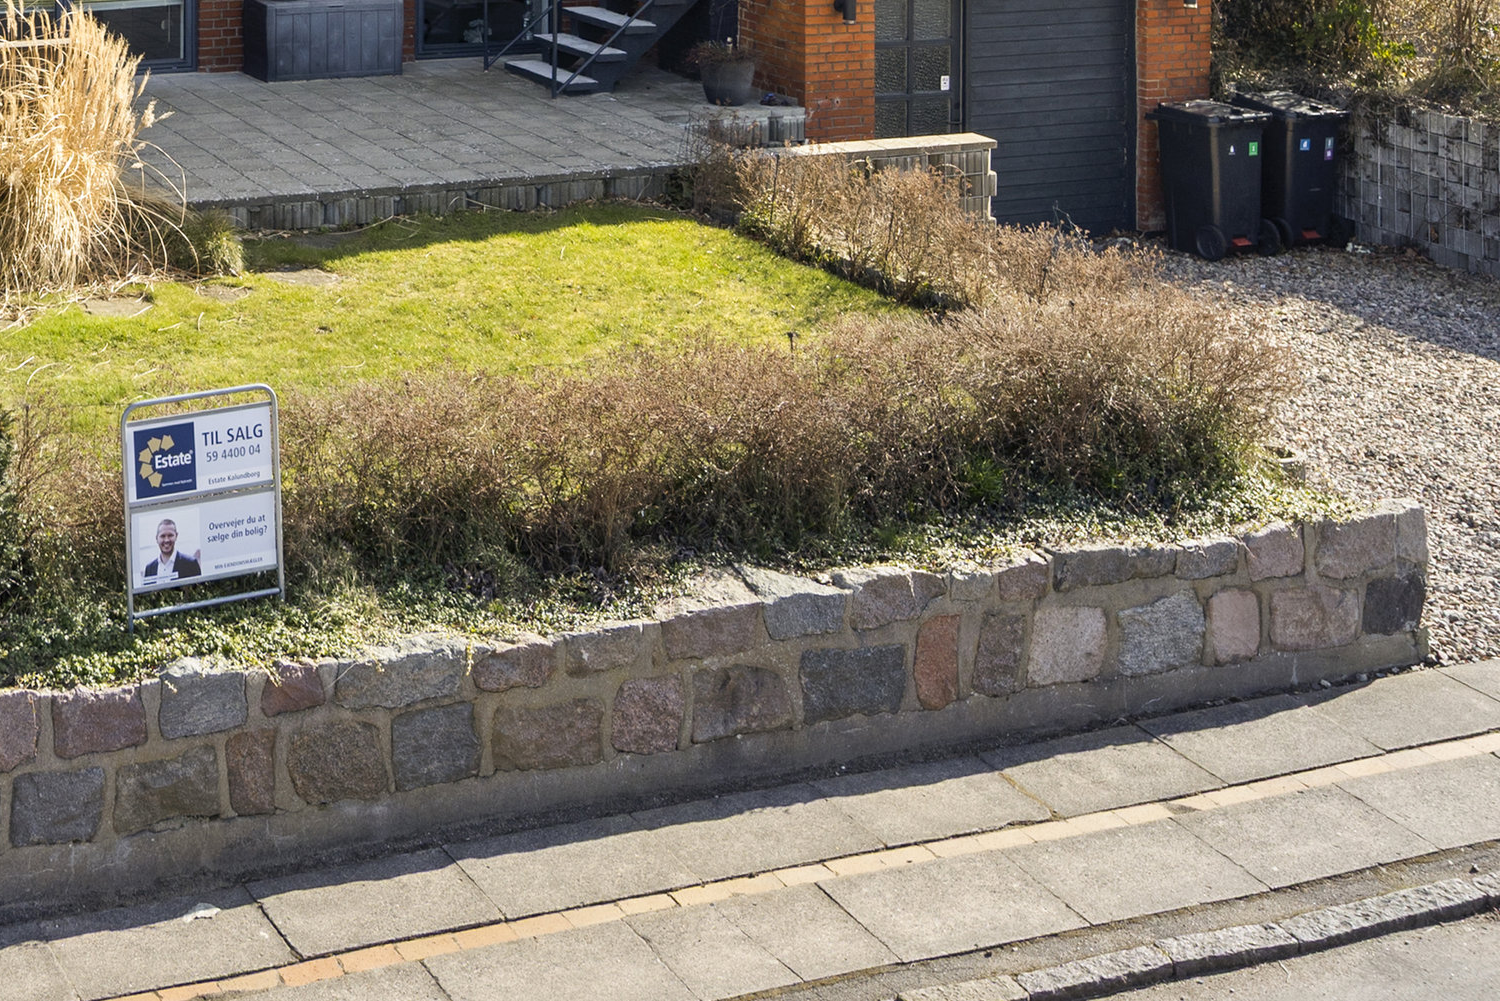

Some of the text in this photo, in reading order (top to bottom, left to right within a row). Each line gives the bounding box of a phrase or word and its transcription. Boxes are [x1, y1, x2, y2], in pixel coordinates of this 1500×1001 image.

[202, 423, 263, 446] TIL SALG
[155, 453, 192, 469] Estate
[206, 444, 261, 462] 59 4400 04
[208, 476, 226, 485] Estate
[209, 514, 265, 530] Overvejer du at
[207, 525, 268, 543] sælge din bolig?
